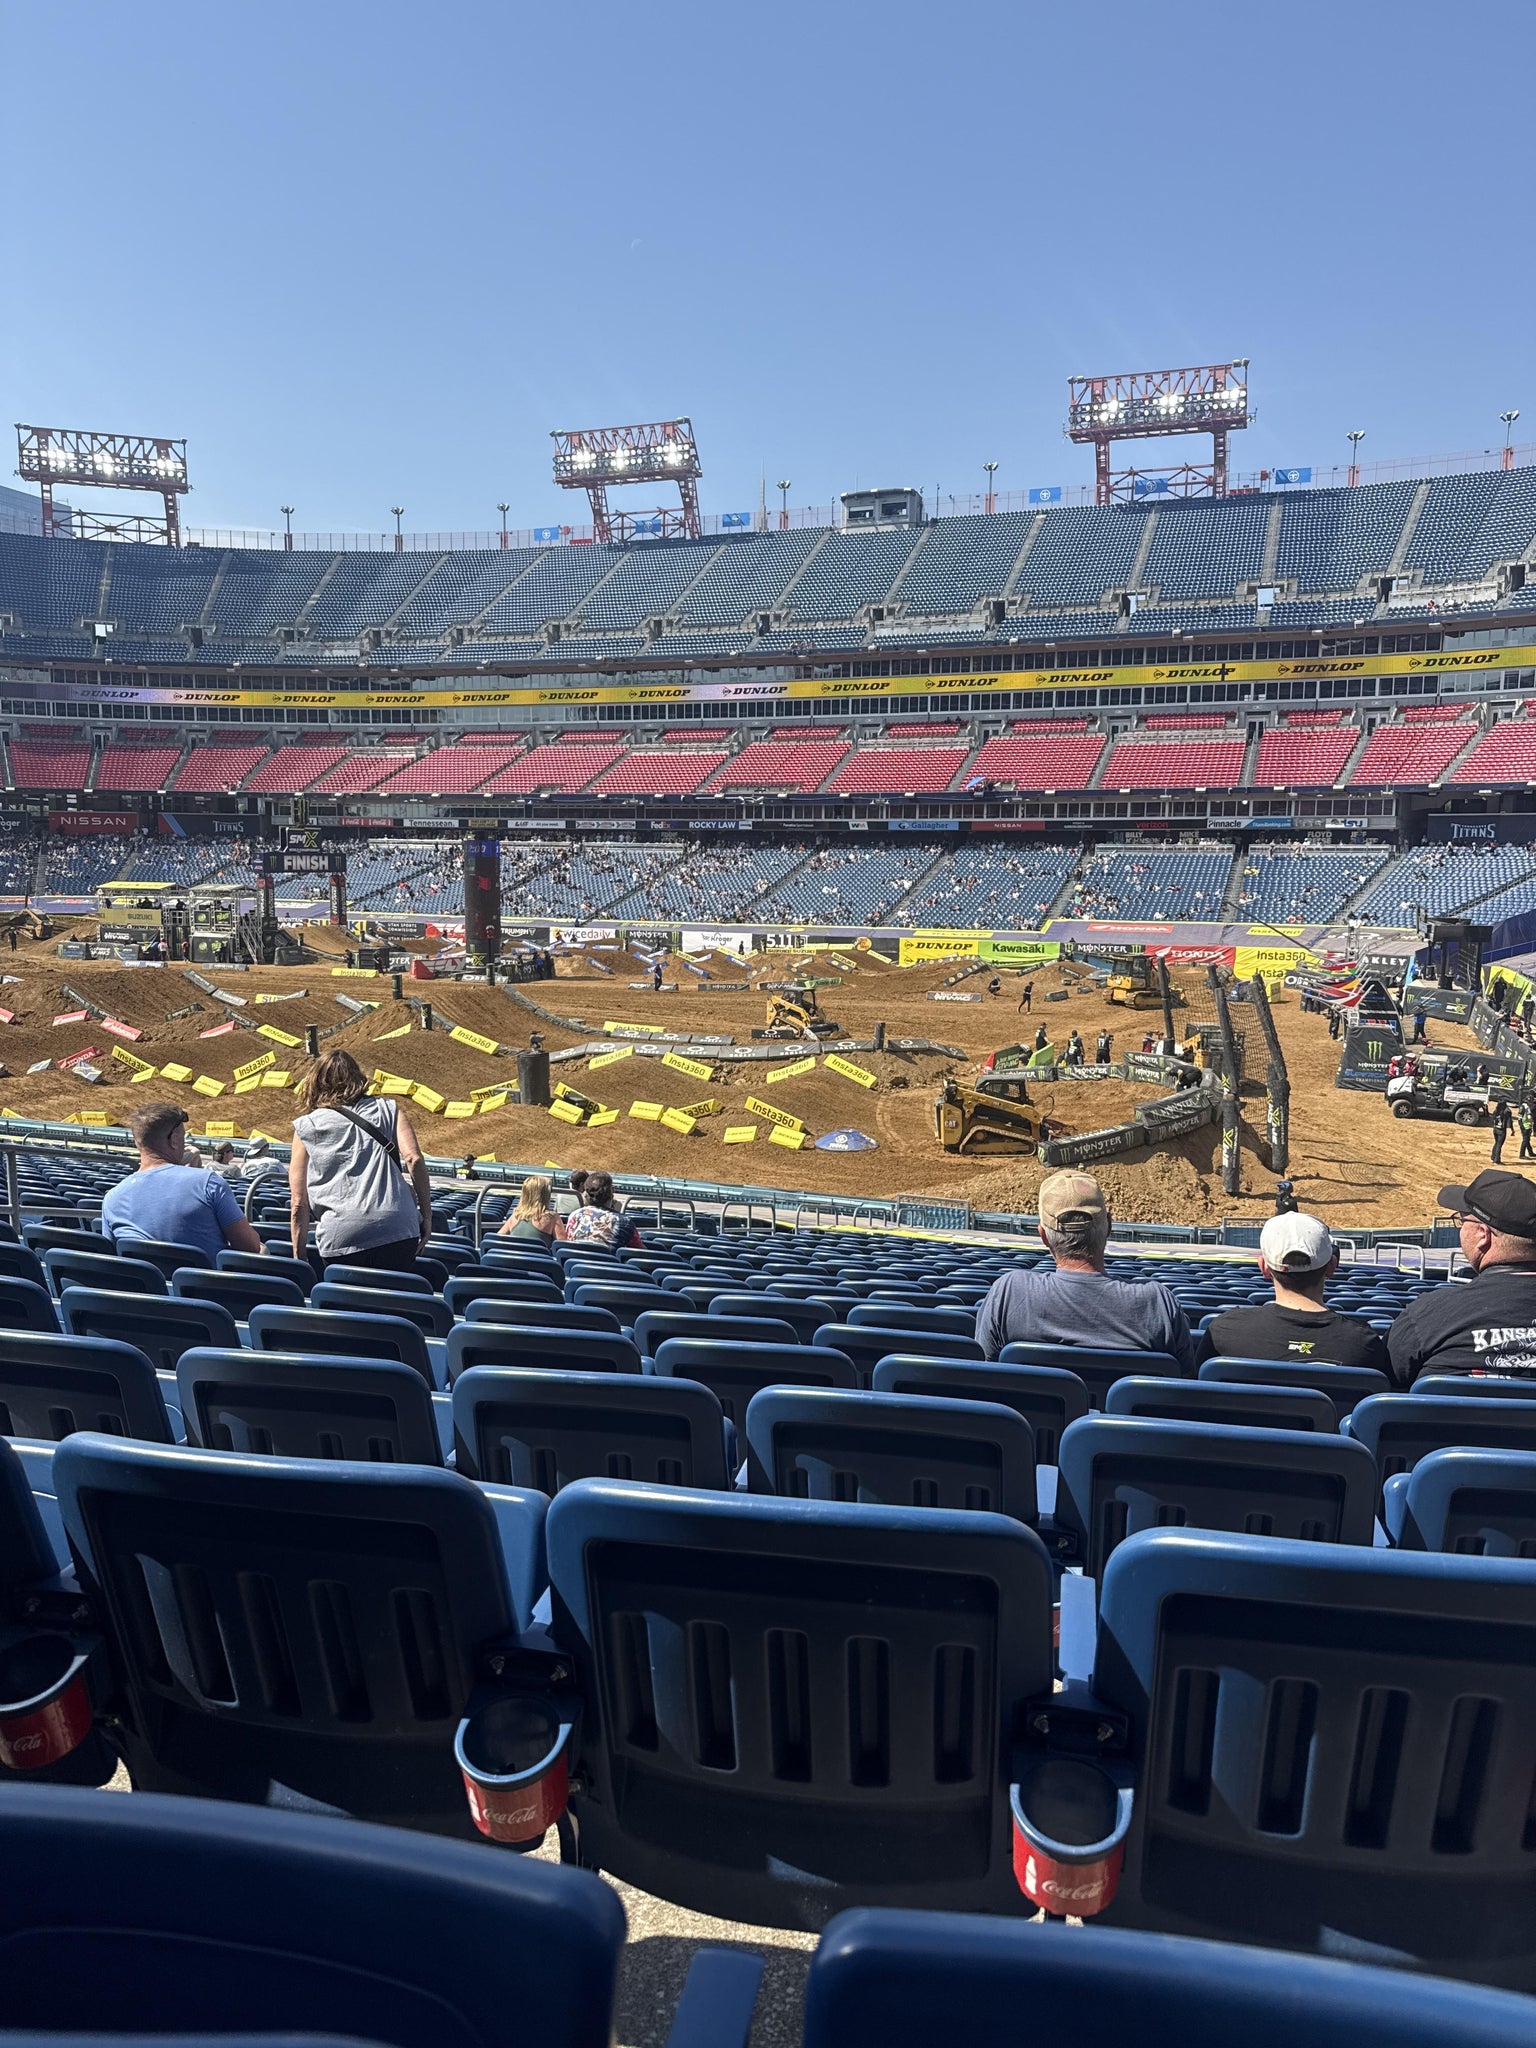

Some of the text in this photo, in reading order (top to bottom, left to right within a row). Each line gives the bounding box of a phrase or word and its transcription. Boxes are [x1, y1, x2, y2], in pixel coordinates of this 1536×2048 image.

[1423, 654, 1501, 668] DUNLOP
[1166, 667, 1236, 679] DUNLOP
[1292, 662, 1365, 675] DUNLOP
[936, 678, 998, 689] DUNLOP
[1048, 673, 1113, 684] DUNLOP
[732, 686, 788, 696] DUNLOP
[833, 682, 890, 693] DUNLOP
[80, 690, 140, 699] DUNLOP
[184, 693, 241, 702] DUNLOP
[283, 695, 336, 703] DUNLOP
[462, 694, 511, 702] DUNLOP
[549, 691, 599, 700] DUNLOP
[638, 689, 691, 698] DUNLOP
[376, 695, 425, 704] DUNLOP
[60, 816, 127, 826] NISSAN
[213, 820, 244, 833] TITANS
[650, 821, 671, 829] FedEx
[689, 821, 736, 830] ROCKY LAW
[911, 822, 949, 830] Gallagher
[1136, 821, 1169, 829] verizon
[1208, 819, 1242, 829] Pinnacle
[1451, 823, 1496, 839] TITANS
[289, 831, 318, 848] SMX
[283, 855, 329, 871] FINISH
[127, 913, 153, 921] SUZUKI
[307, 919, 365, 931] SUKI
[500, 928, 529, 936] TRIUMPH
[629, 931, 668, 940] MONSTER
[711, 932, 733, 945] Kroger
[766, 933, 794, 949] 5.11
[916, 943, 973, 951] DUNLOP
[992, 943, 1045, 954] Kawasaki
[1078, 943, 1128, 954] MONSTER
[1172, 949, 1226, 960] HONDA
[1256, 950, 1306, 962] Insta360
[1361, 956, 1408, 967] AKLEY
[1255, 967, 1285, 979] Insta
[457, 1030, 492, 1050] Insta360
[67, 1051, 95, 1070] HONDA
[594, 1049, 628, 1067] Insta360
[239, 1055, 271, 1077] Insta360
[668, 1056, 706, 1077] Insta360
[773, 1060, 810, 1079] Insta360
[832, 1057, 870, 1082] Insta360
[1160, 1097, 1199, 1117] MONSTER
[751, 1101, 795, 1129] Insta360
[1168, 1115, 1200, 1134] MONSTER
[1073, 1135, 1122, 1155] MONSTER
[1471, 1327, 1536, 1353] KANSA
